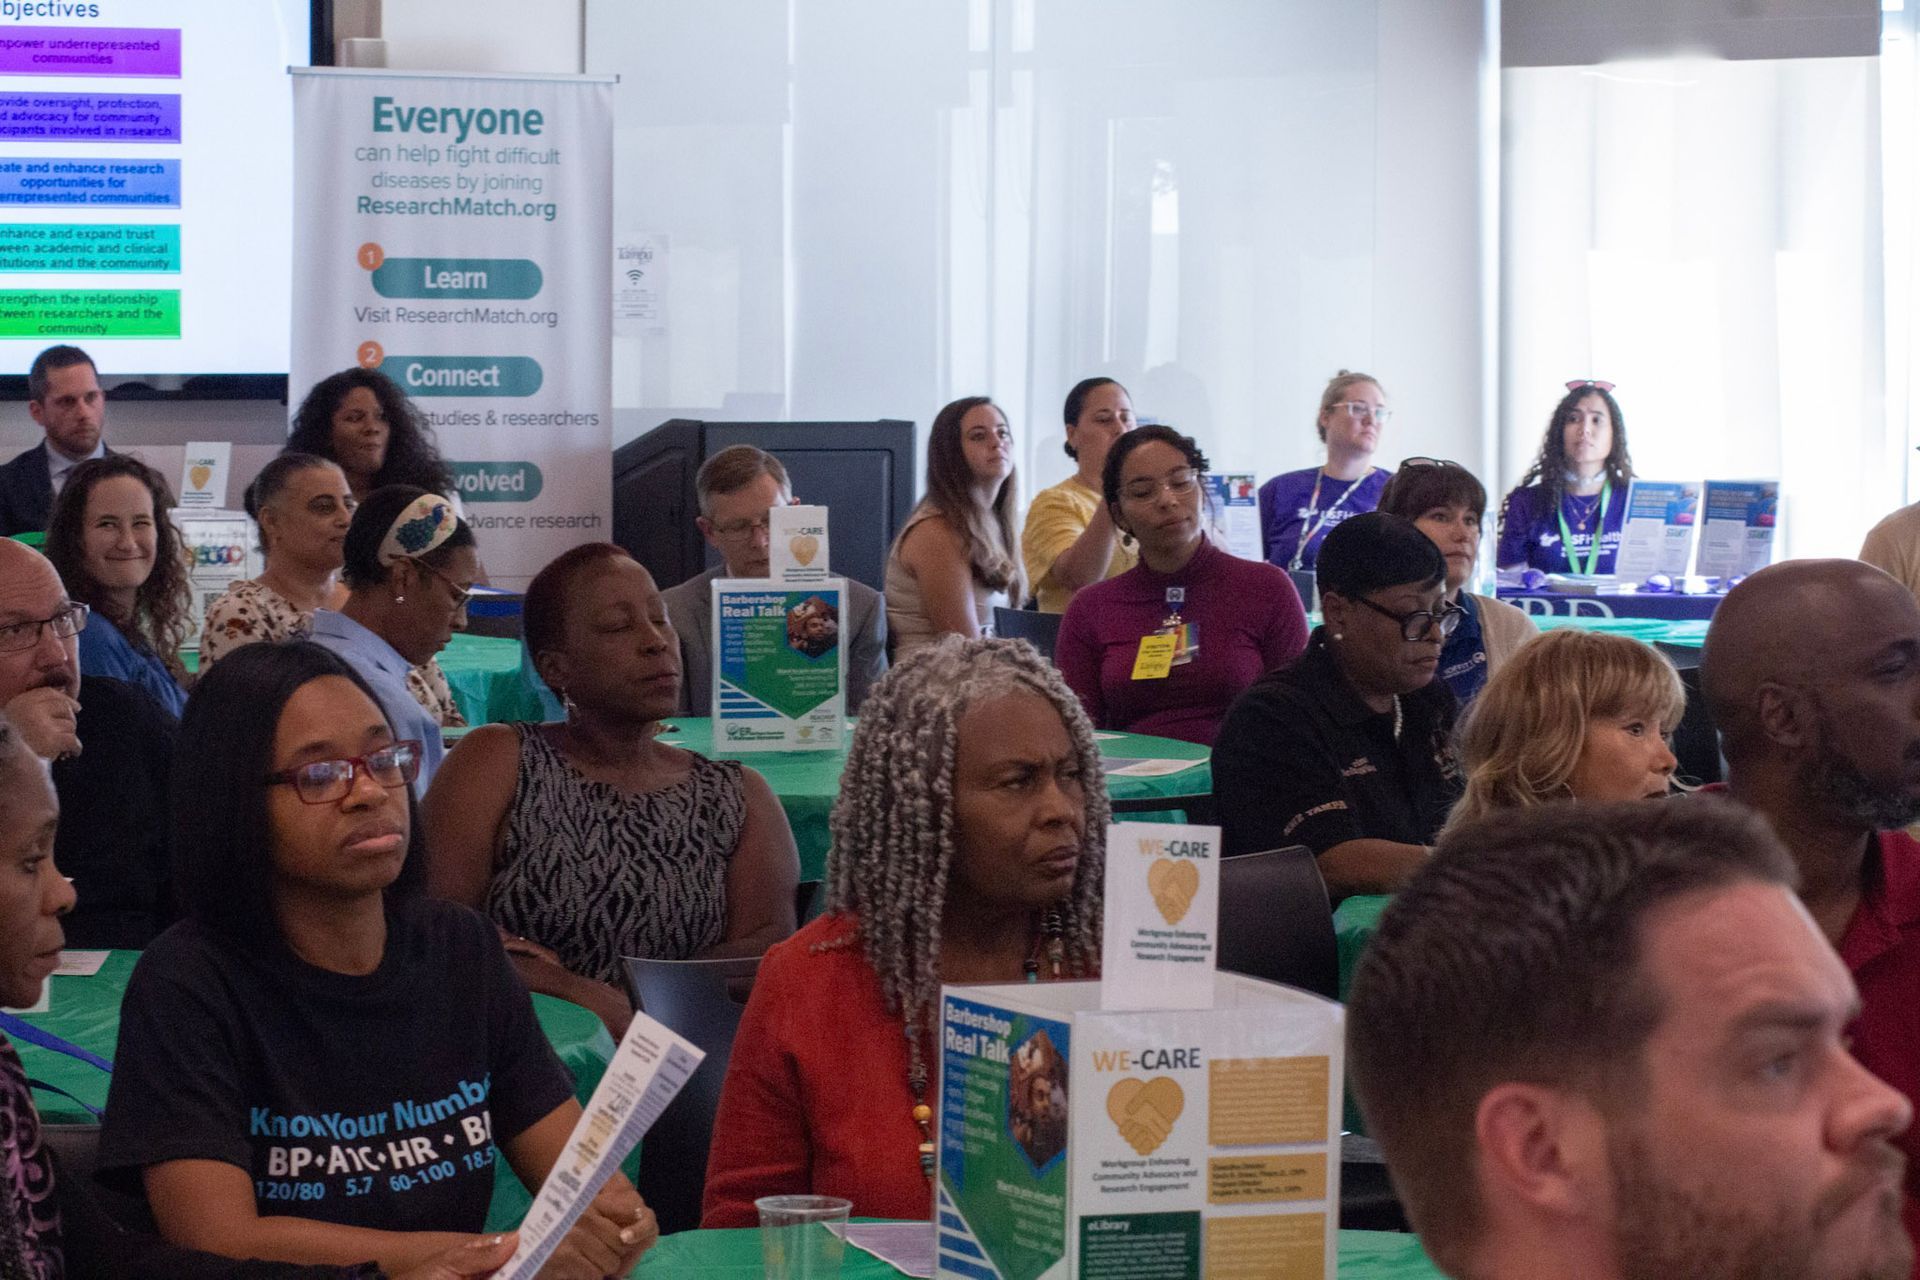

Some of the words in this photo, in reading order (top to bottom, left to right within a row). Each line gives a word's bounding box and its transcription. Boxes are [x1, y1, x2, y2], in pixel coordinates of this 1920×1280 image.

[50, 38, 160, 51] underrepresented
[32, 53, 114, 64] communities
[12, 111, 68, 124] advocacy
[74, 111, 90, 122] for
[93, 112, 160, 125] community
[372, 96, 545, 144] Everyone
[51, 126, 100, 136] involved
[105, 126, 116, 135] in
[119, 126, 172, 137] research
[355, 148, 391, 162] can
[396, 145, 440, 167] help
[446, 145, 490, 168] fight
[495, 147, 561, 165] difficult
[27, 162, 49, 173] and
[53, 162, 106, 174] enhance
[110, 163, 164, 174] research
[20, 177, 104, 190] opportunities
[108, 177, 126, 188] for
[371, 171, 450, 190] diseases
[456, 172, 479, 193] by
[481, 174, 543, 195] joining
[90, 192, 170, 203] communities
[356, 196, 557, 222] ResearchMatch.org
[50, 229, 72, 239] and
[77, 229, 122, 241] expand
[126, 229, 155, 240] trust
[34, 243, 94, 253] academic
[98, 243, 120, 253] and
[124, 243, 168, 254] clinical
[51, 257, 74, 268] and
[78, 257, 96, 268] the
[100, 258, 170, 270] community
[366, 250, 376, 264] 1
[424, 265, 487, 290] Learn
[61, 294, 80, 304] the
[84, 294, 158, 306] relationship
[39, 308, 113, 319] researchers
[117, 308, 140, 318] and
[144, 308, 163, 319] the
[355, 307, 391, 323] Visit
[396, 307, 558, 328] ResearchMatch.org
[38, 323, 108, 335] community
[365, 347, 377, 363] 2
[406, 363, 501, 387] Connect
[423, 411, 481, 426] studies
[485, 410, 497, 425] &
[502, 410, 600, 426] researchers
[529, 513, 601, 529] research
[722, 594, 787, 605] Barbershop
[722, 606, 754, 617] Real
[757, 605, 786, 617] Talk
[1138, 838, 1210, 859] WE-CARE
[945, 1003, 1012, 1039] Barbershop
[945, 1026, 977, 1056] Real
[980, 1035, 1010, 1065] Talk
[1092, 1048, 1201, 1072] WE-CARE
[323, 1112, 388, 1140] Your
[268, 1146, 313, 1177] BP
[387, 1136, 439, 1169] HR
[1101, 1160, 1147, 1169] Workgroup
[1148, 1157, 1190, 1167] Enhancing
[256, 1181, 326, 1200] 120/80
[345, 1176, 374, 1197] 5.7
[389, 1160, 456, 1192] 60-100
[1092, 1172, 1139, 1182] Community
[1142, 1171, 1181, 1180] Advocacy
[1182, 1169, 1198, 1177] and
[1100, 1183, 1138, 1193] Research
[1139, 1182, 1189, 1193] Engagement
[1087, 1219, 1131, 1232] eLibrary
